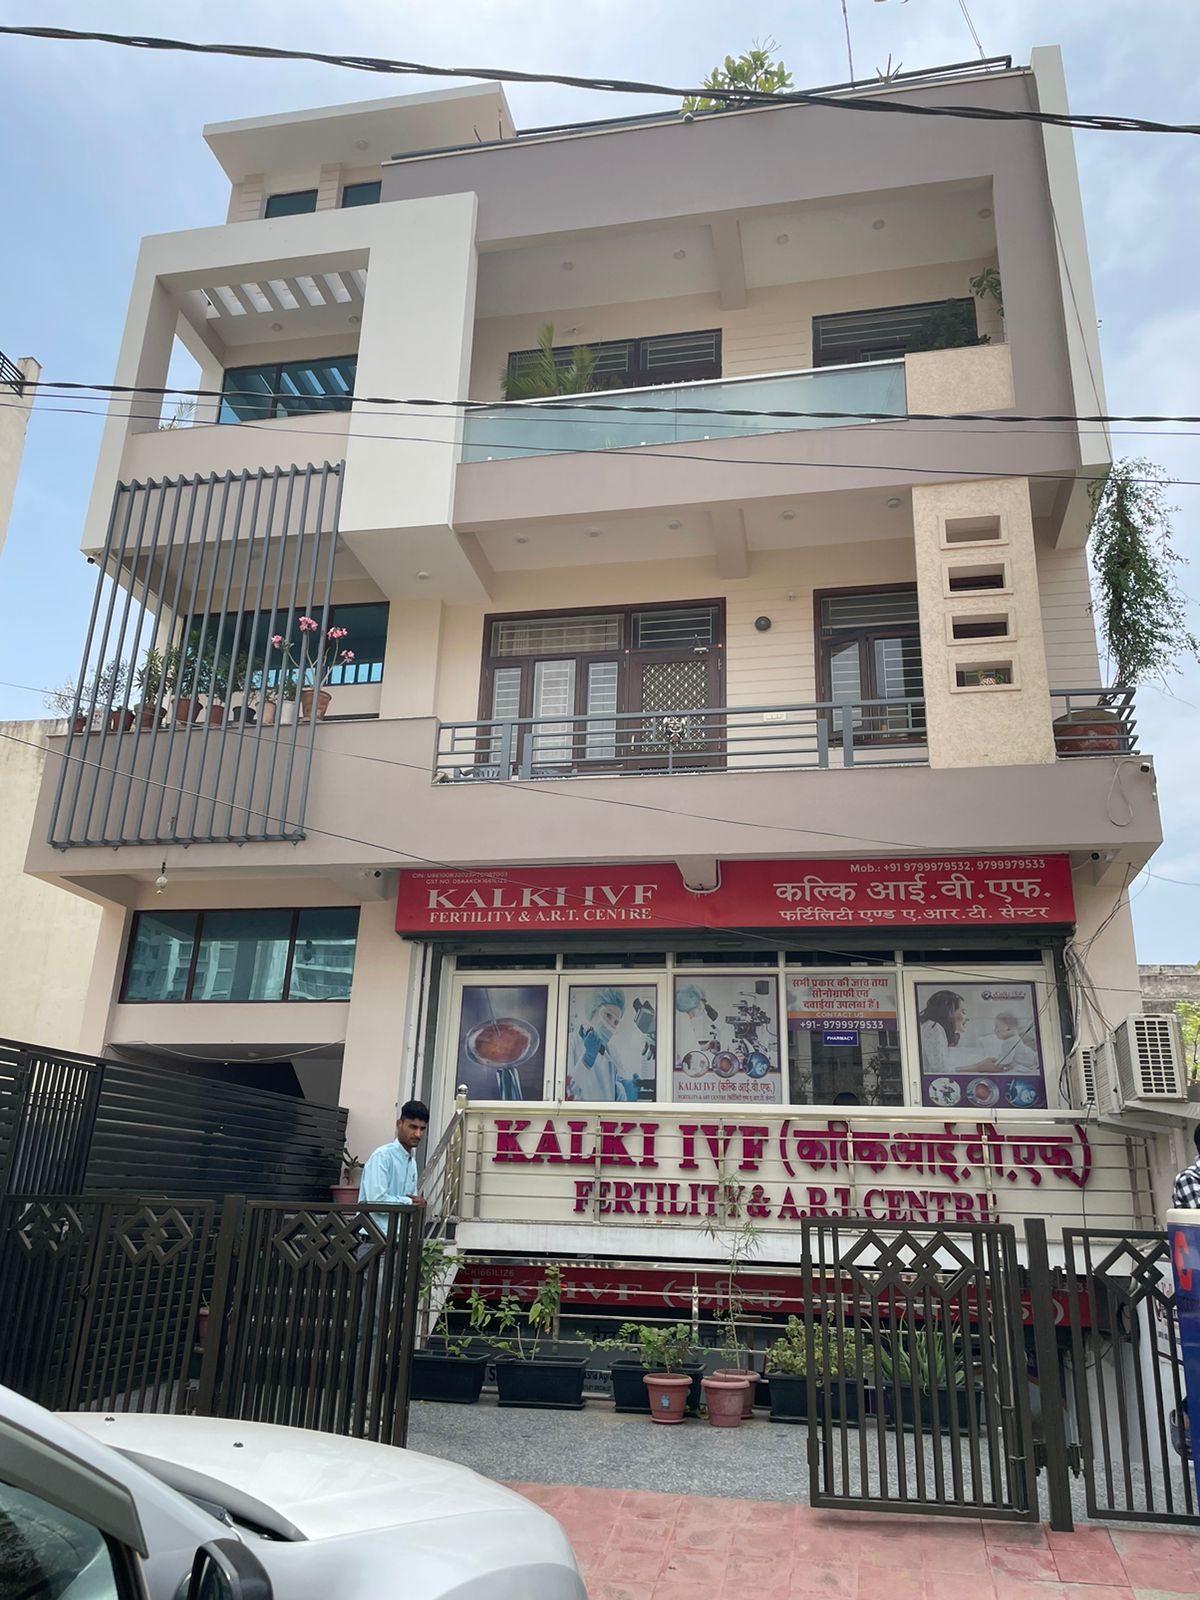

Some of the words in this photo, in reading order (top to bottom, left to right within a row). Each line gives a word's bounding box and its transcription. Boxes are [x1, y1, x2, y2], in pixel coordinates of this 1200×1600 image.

[850, 863, 880, 873] Mob.:
[883, 862, 900, 872] +91
[903, 861, 974, 872] 9799979532,
[976, 859, 1046, 870] 9799979533
[425, 887, 569, 909] KALKI
[582, 884, 659, 907] IVF
[772, 875, 858, 902] कल्कि
[429, 910, 516, 923] FERTILITY
[517, 910, 530, 922] &
[534, 909, 579, 922] A.R.T.
[583, 908, 652, 921] CENTRE
[778, 905, 853, 922] फर्टिलिटी
[858, 909, 896, 923] एण्ड
[998, 903, 1050, 919] सेन्टर
[823, 1020, 884, 1029] 9799979533
[492, 1120, 659, 1167] KALKI
[678, 1124, 769, 1171] IVF
[573, 1181, 746, 1219] FERTILITY
[746, 1184, 771, 1218] &
[863, 1188, 1000, 1224] CENTRE
